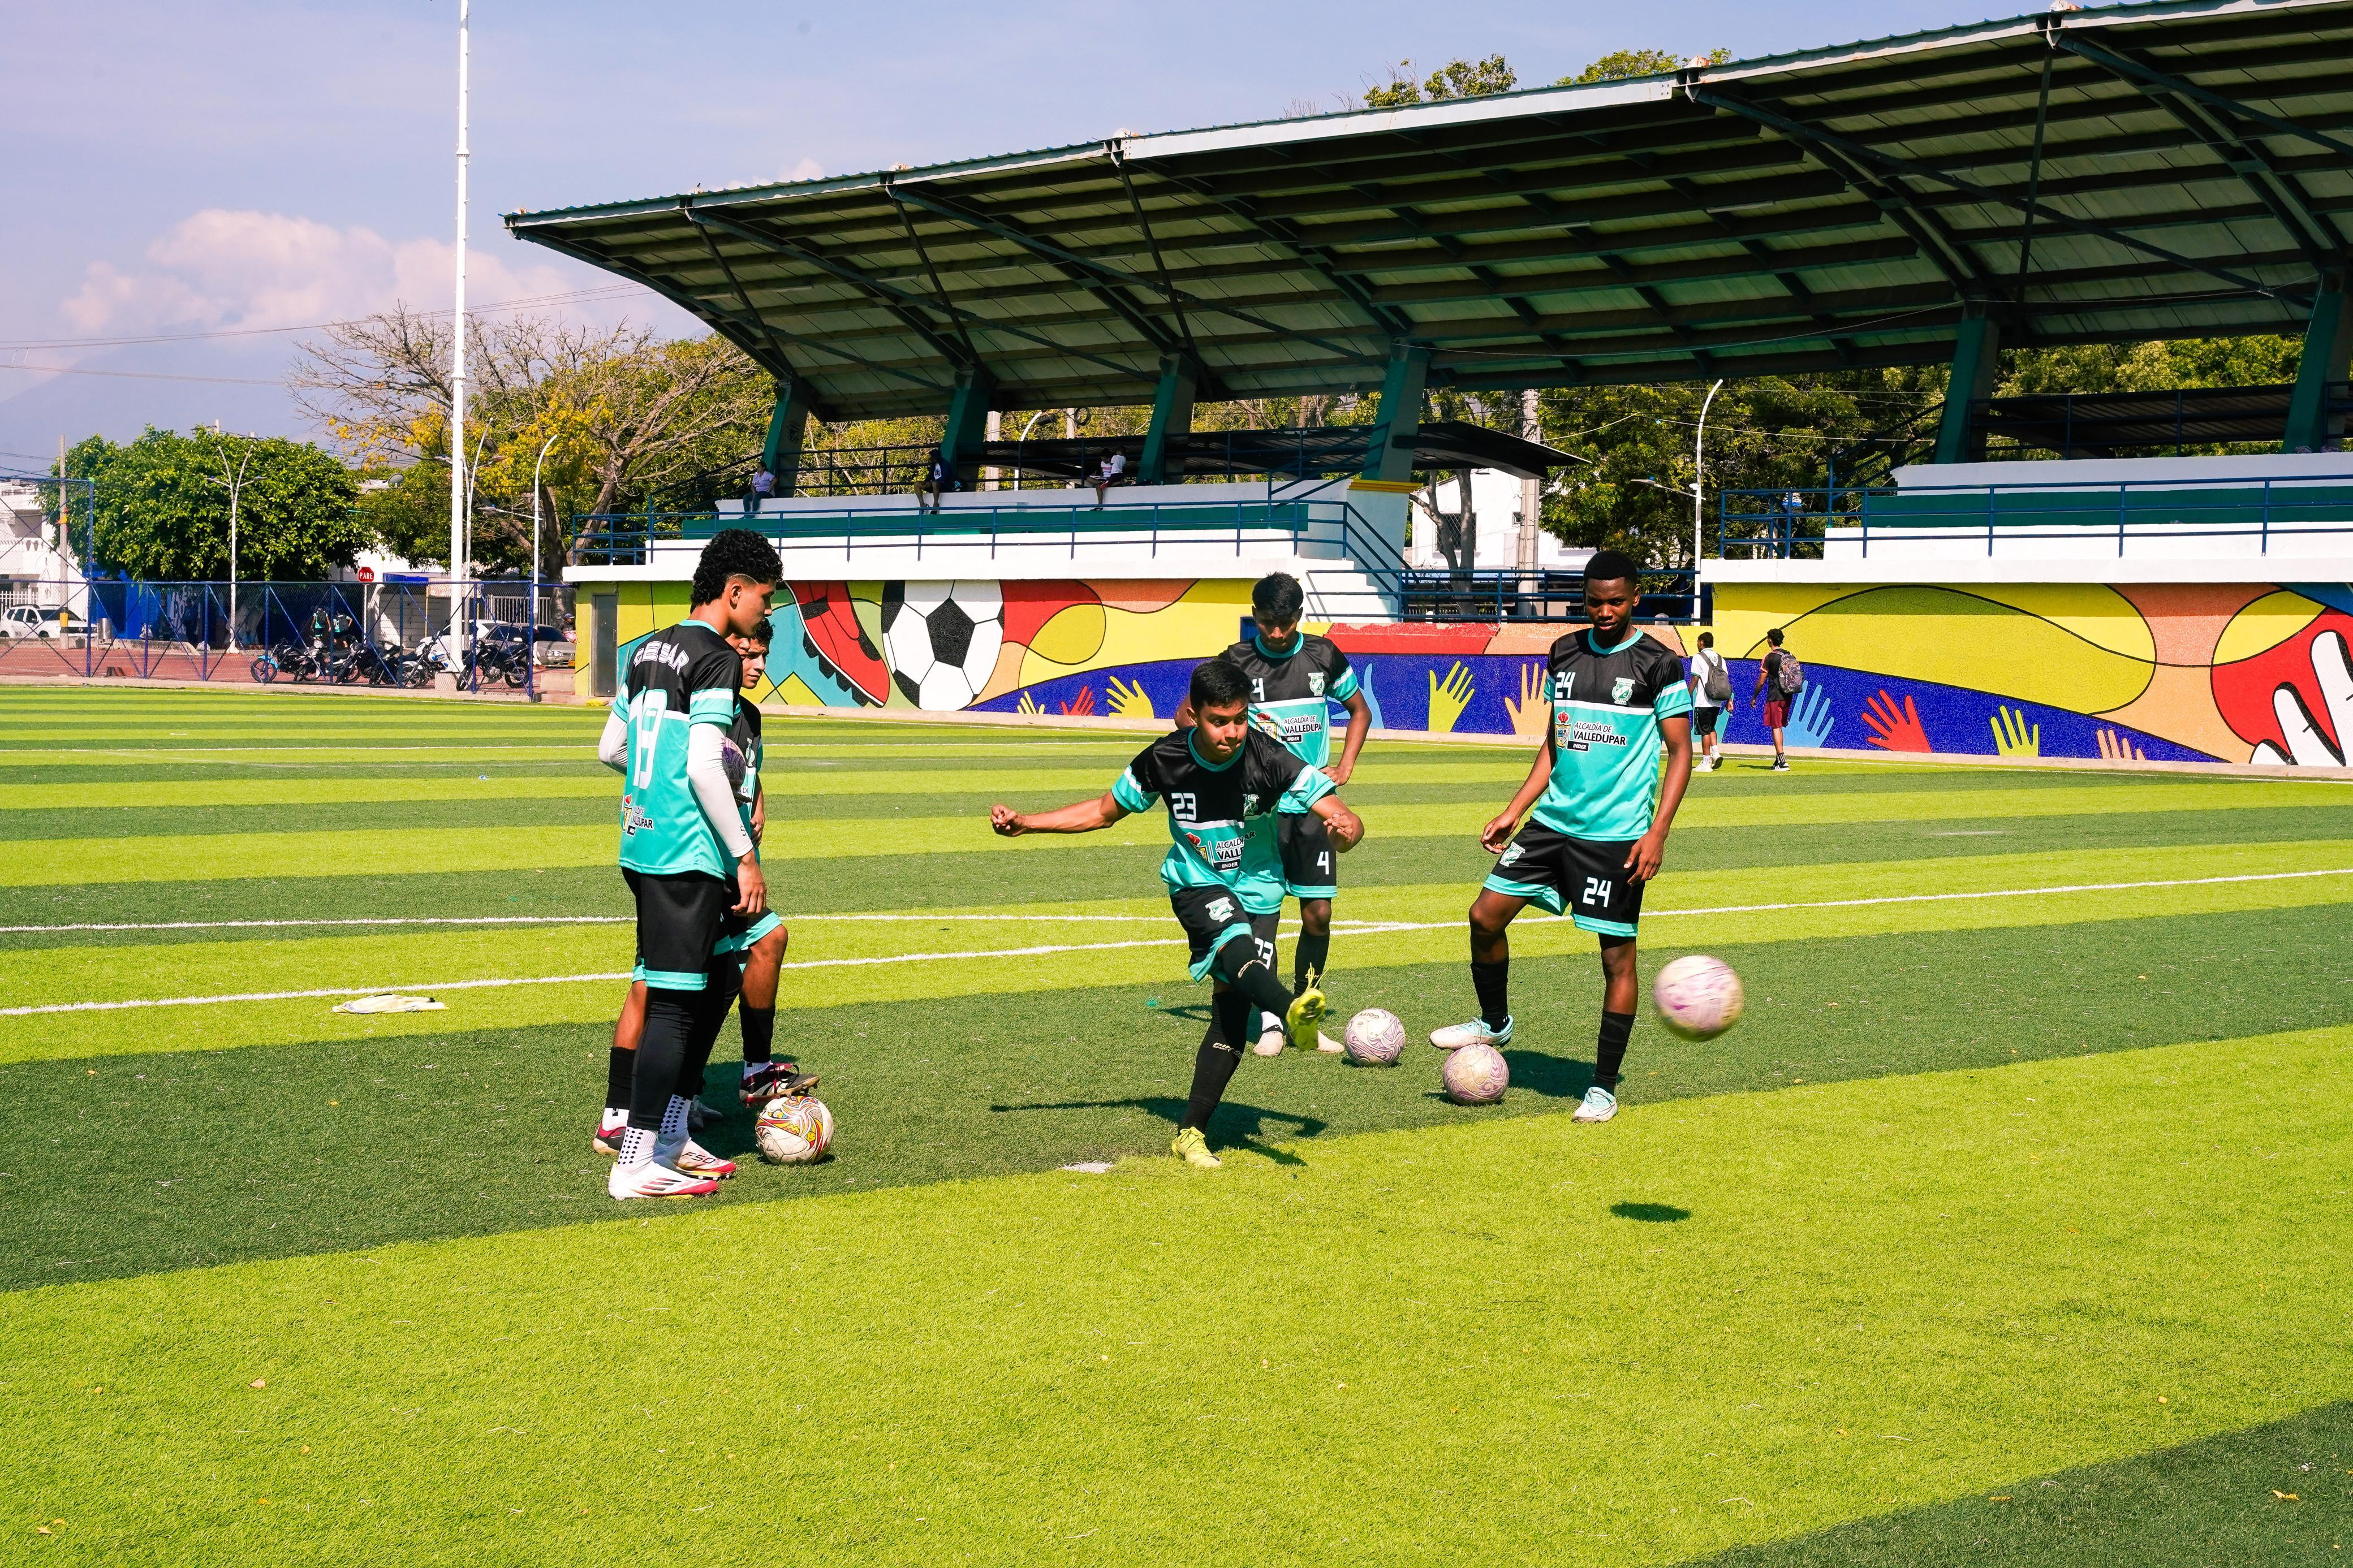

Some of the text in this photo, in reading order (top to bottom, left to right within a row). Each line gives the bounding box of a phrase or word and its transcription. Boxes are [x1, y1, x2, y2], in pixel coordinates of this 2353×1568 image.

[634, 641, 689, 675] CESAR
[1252, 678, 1265, 701] 4
[1554, 671, 1576, 699] 24
[1284, 715, 1309, 724] ALCALDÍA
[1574, 722, 1601, 731] ALCALDÍA
[1574, 730, 1626, 745] VALLEDUPAR
[1171, 793, 1197, 821] 23
[1317, 851, 1329, 875] 4
[1582, 876, 1612, 908] 24
[680, 1152, 716, 1164] F50
